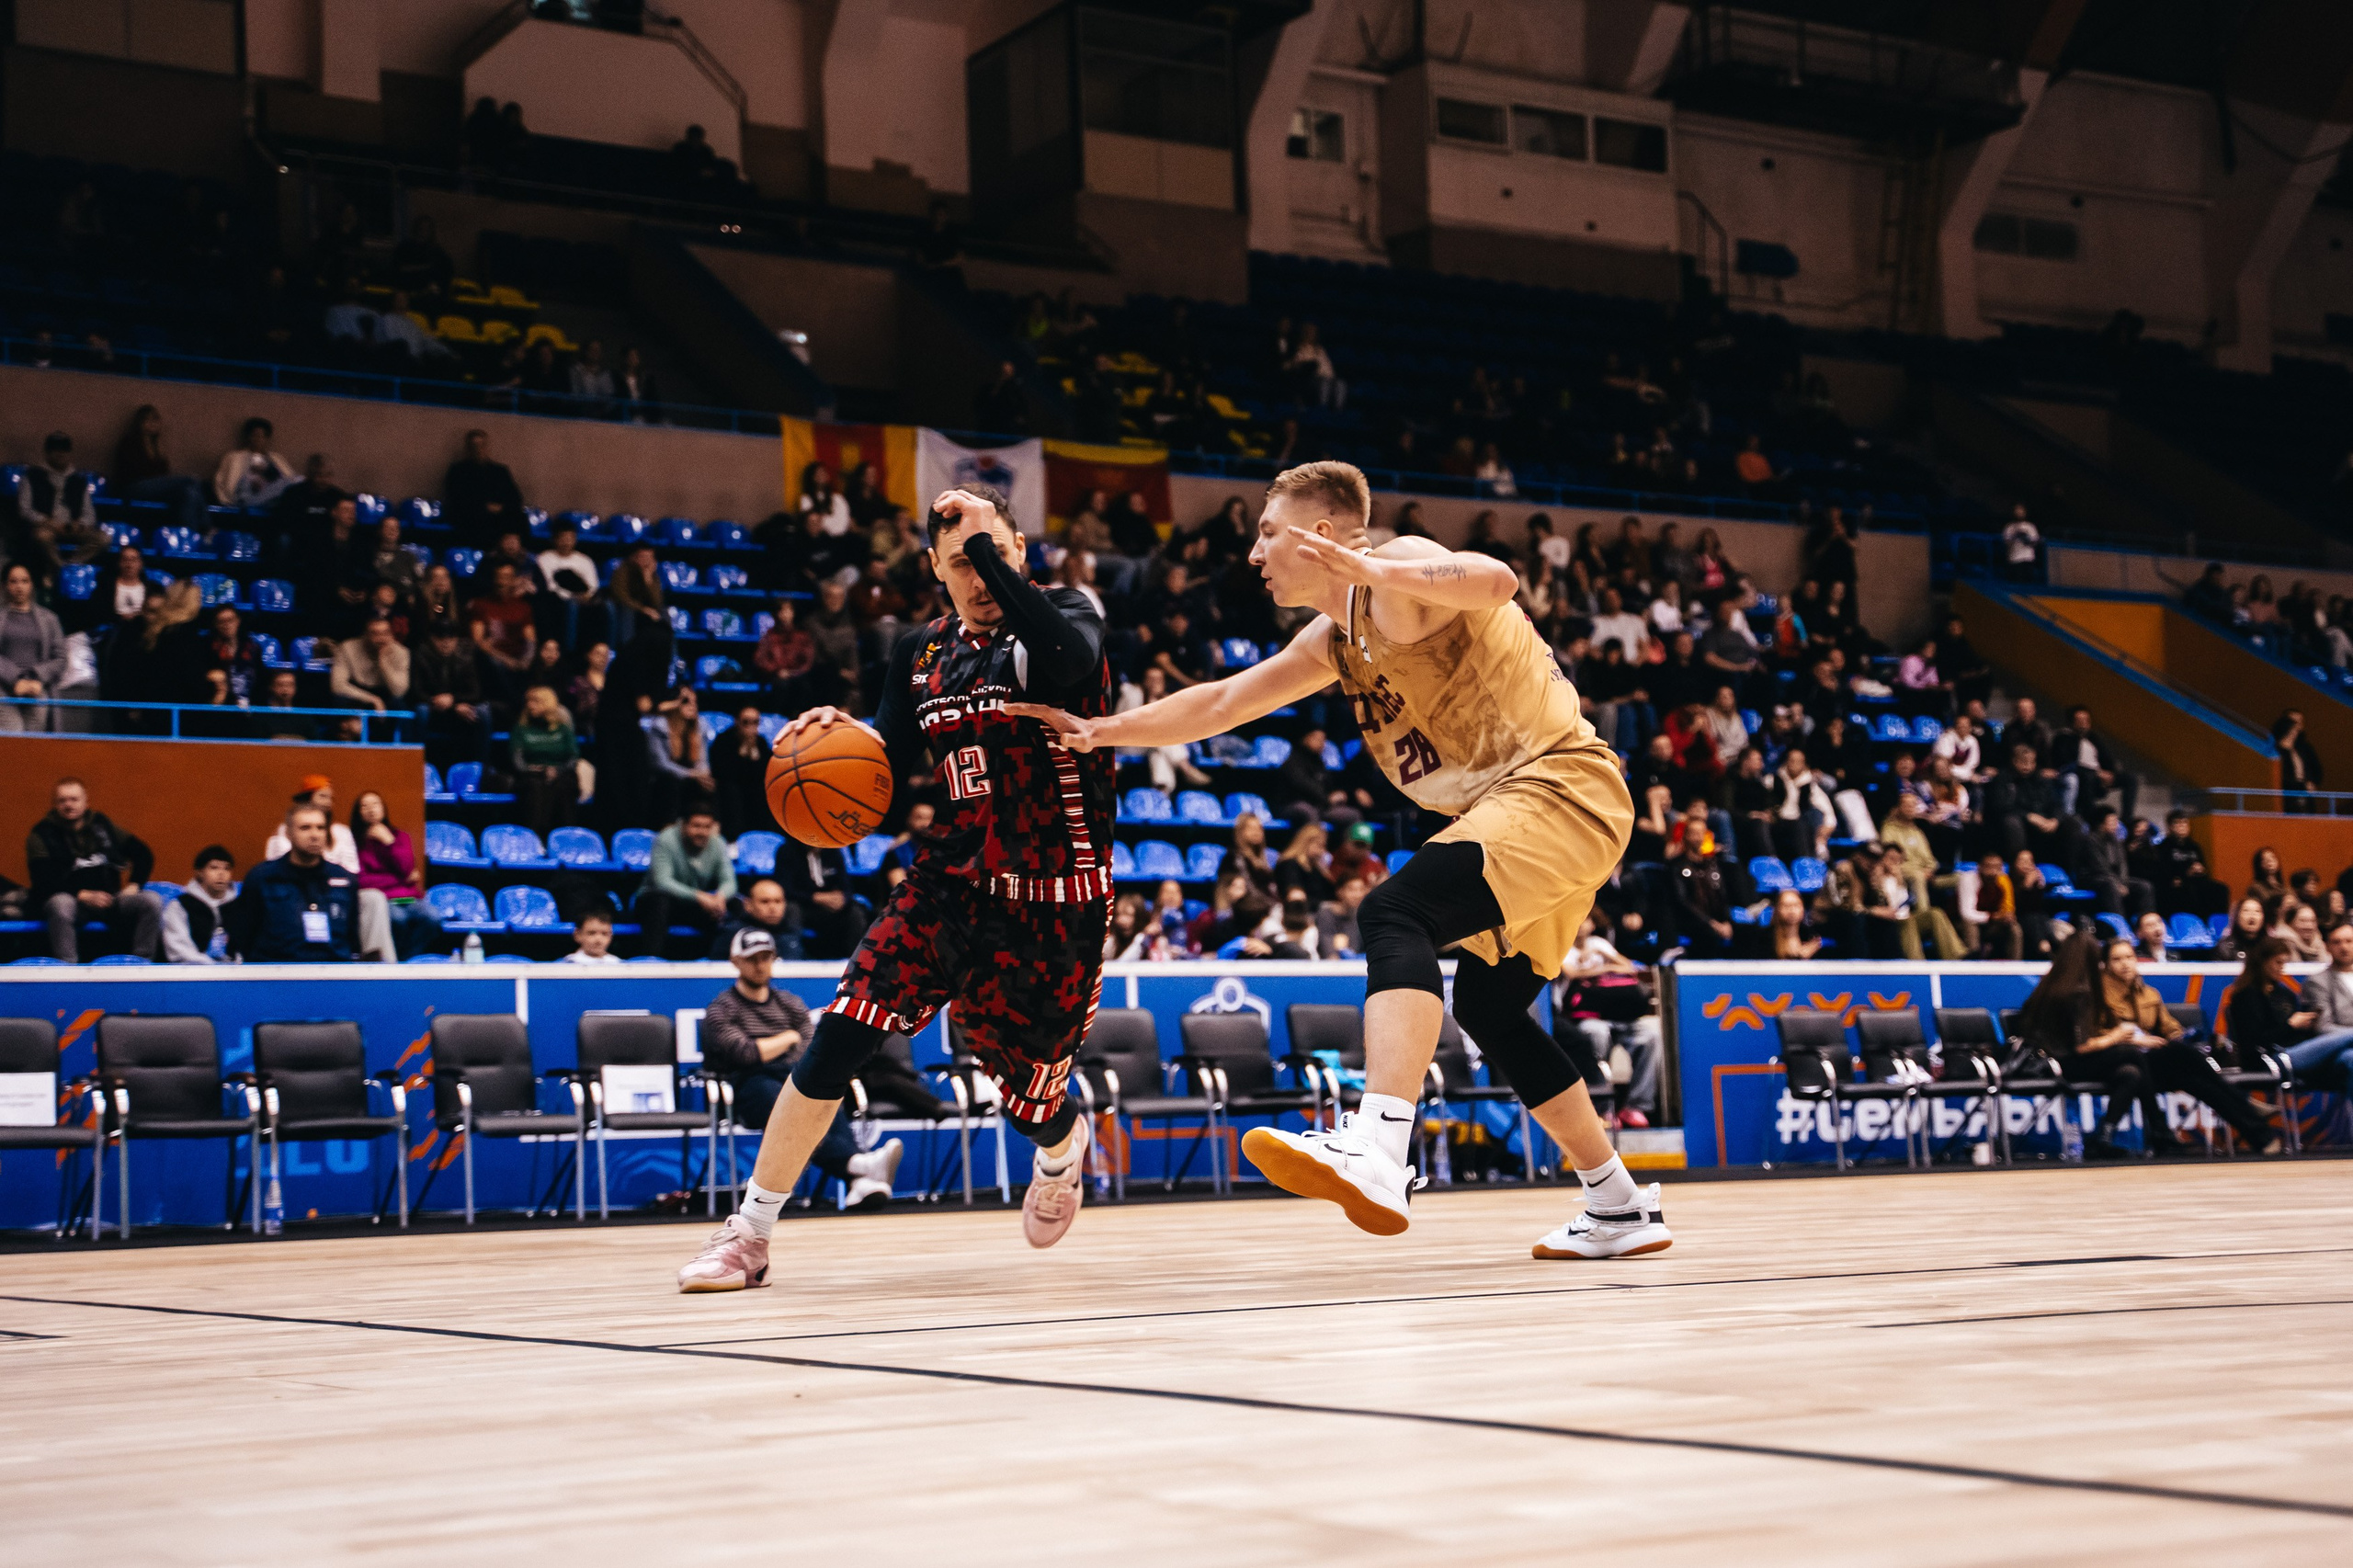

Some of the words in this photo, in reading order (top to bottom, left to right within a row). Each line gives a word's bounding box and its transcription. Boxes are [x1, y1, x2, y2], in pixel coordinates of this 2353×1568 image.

[944, 745, 991, 801] 12
[1394, 726, 1442, 786] 28
[1026, 1054, 1073, 1100] 12
